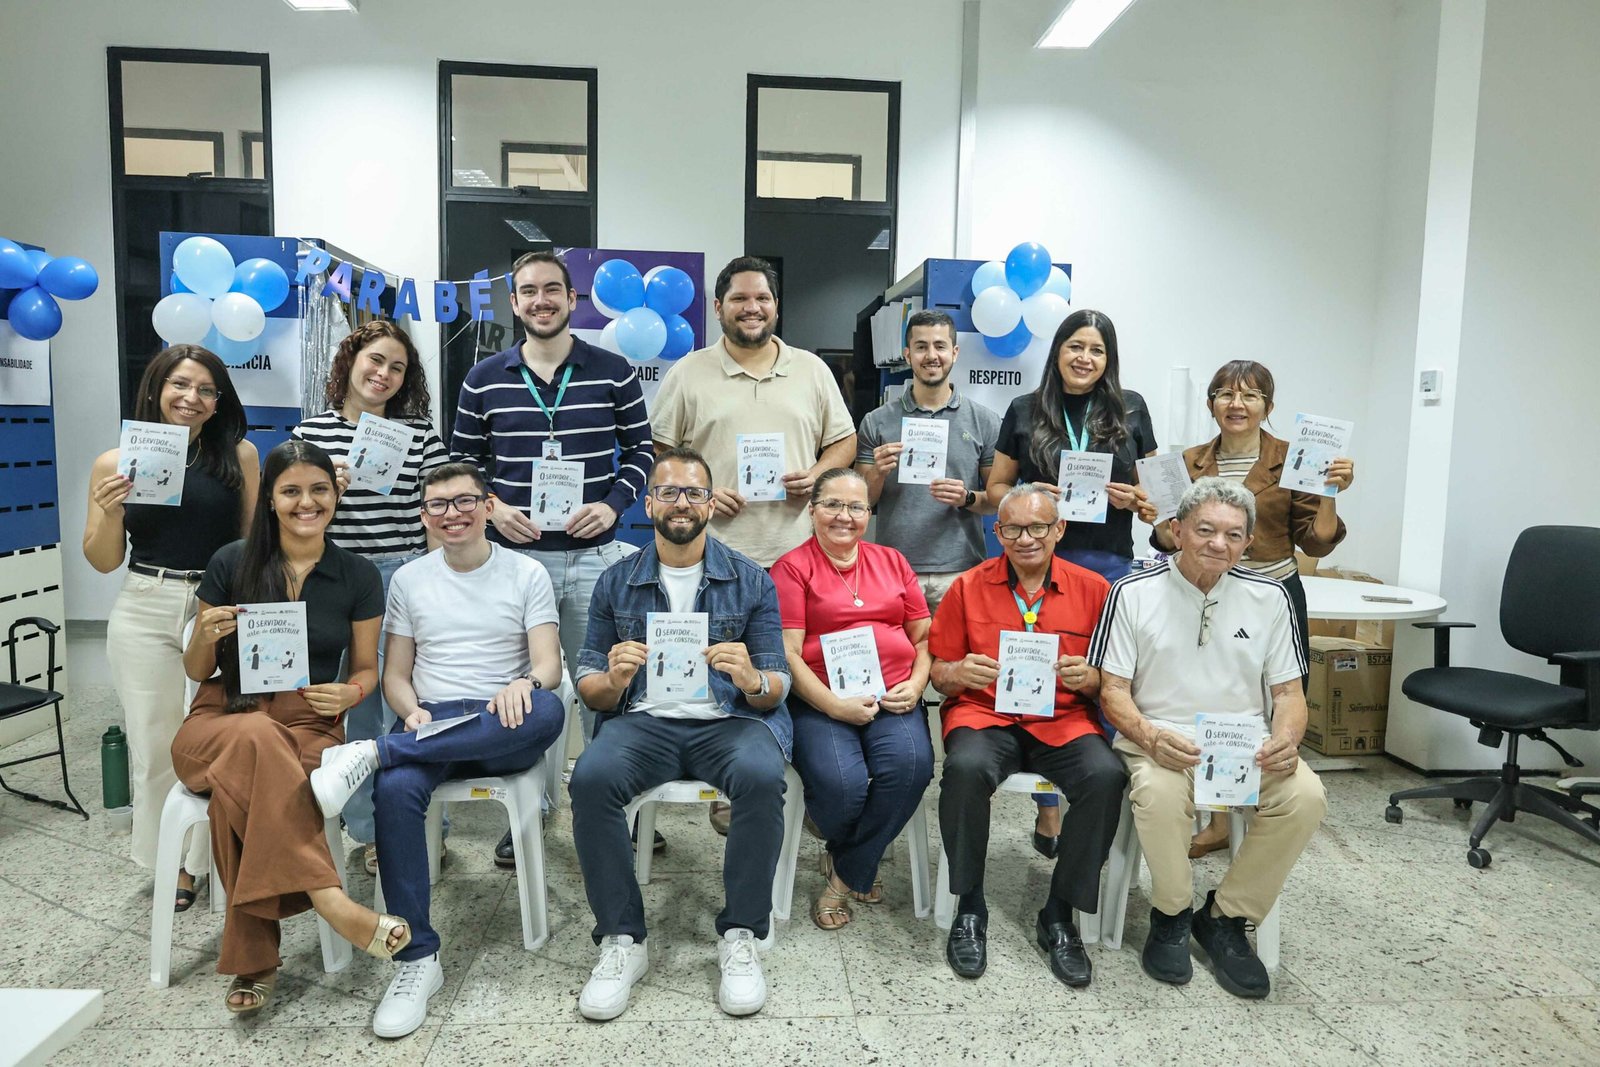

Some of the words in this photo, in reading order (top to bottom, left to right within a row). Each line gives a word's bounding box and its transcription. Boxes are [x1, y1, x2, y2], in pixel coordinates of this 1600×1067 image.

[295, 247, 512, 323] PARABÉ
[969, 369, 1022, 386] RESPEITO
[1301, 427, 1308, 436] O
[1308, 428, 1334, 439] SERVIDOR
[130, 435, 138, 444] O
[138, 437, 169, 446] SERVIDOR
[248, 619, 255, 629] O
[256, 619, 287, 628] SERVIDOR
[656, 628, 661, 637] O
[831, 646, 836, 655] O
[1008, 645, 1014, 654] O
[1014, 646, 1041, 655] SERVIDOR
[1205, 729, 1212, 739] O
[1213, 731, 1244, 740] SERVIDOR
[1226, 740, 1256, 750] CONSTRUIR
